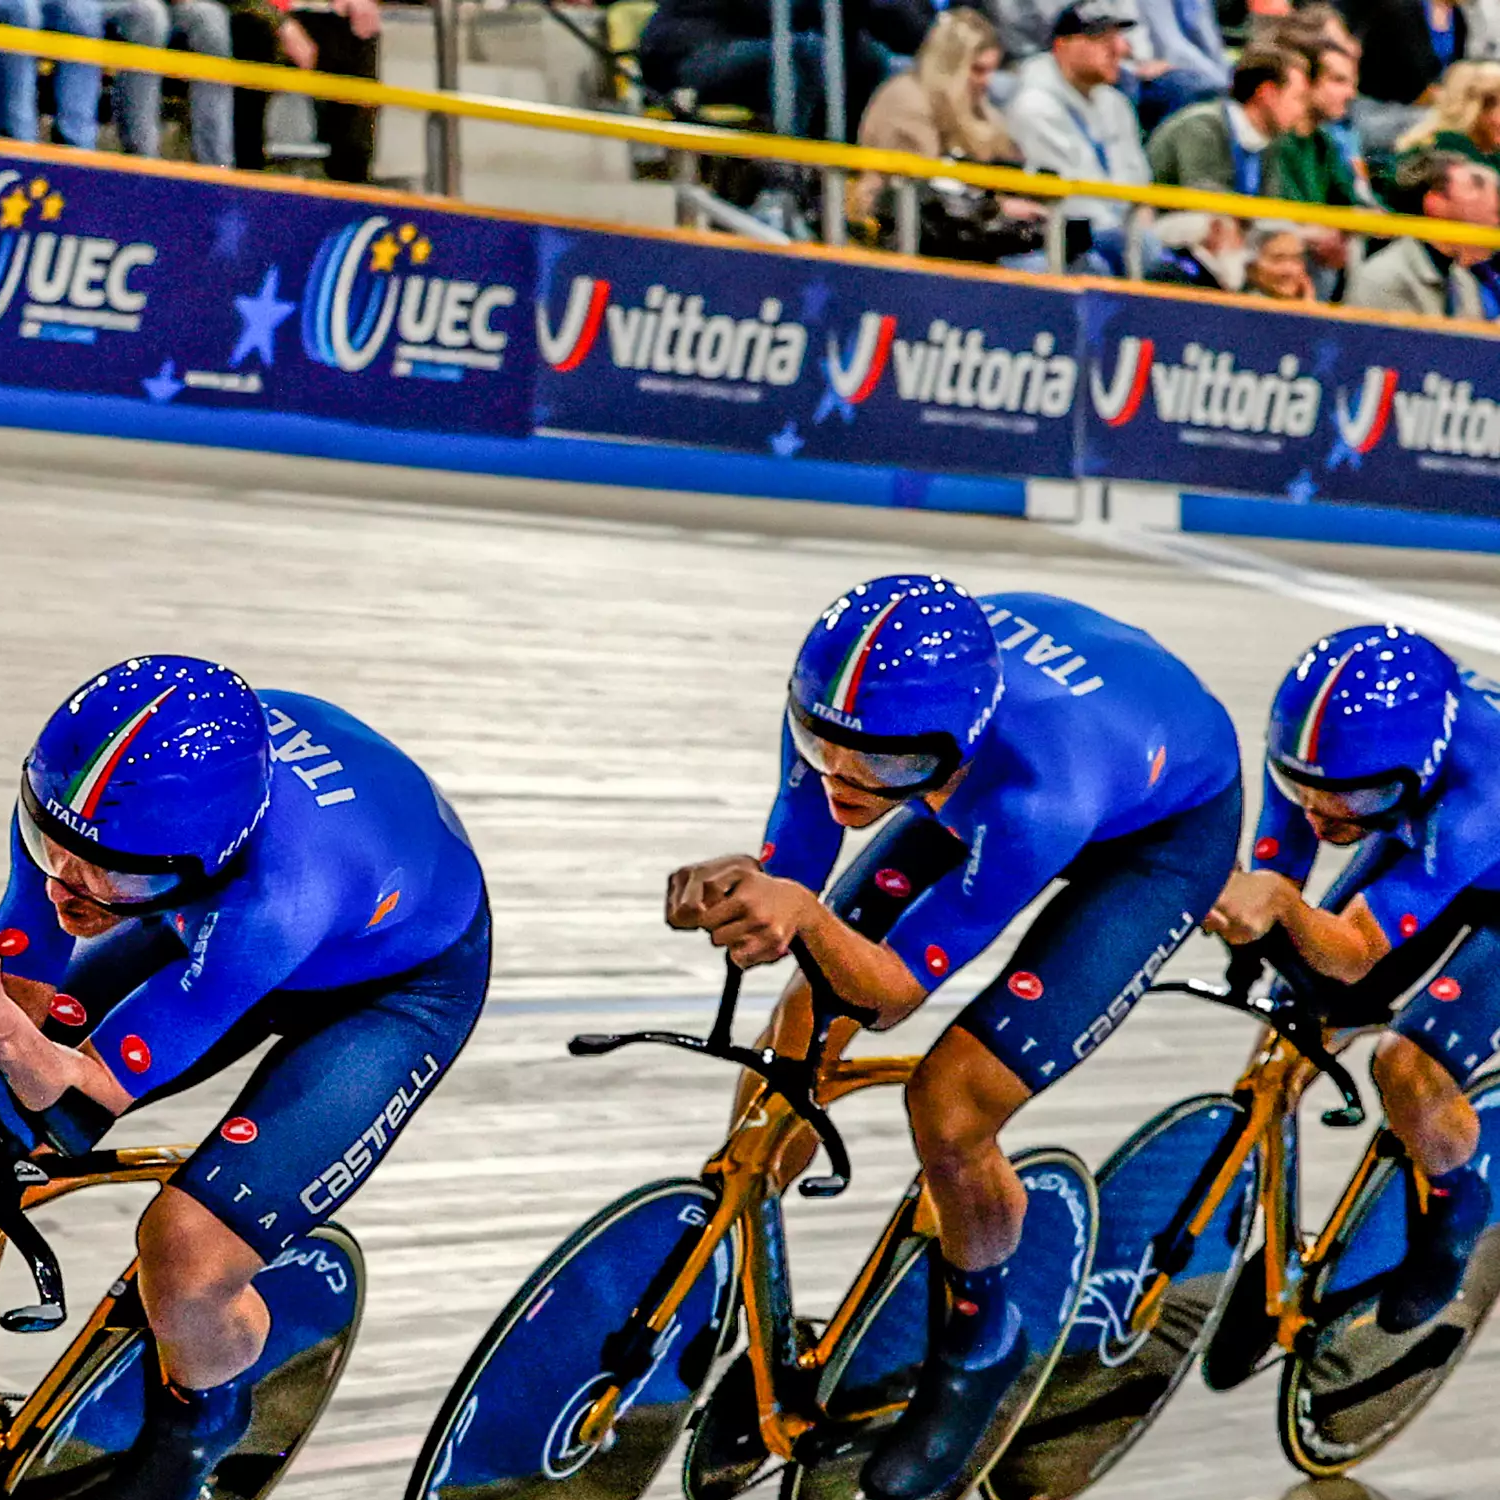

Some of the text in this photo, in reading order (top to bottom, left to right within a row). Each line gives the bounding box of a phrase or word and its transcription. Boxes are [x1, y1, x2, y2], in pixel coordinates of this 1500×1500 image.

[26, 232, 157, 313] UEC
[398, 276, 515, 351] UEC
[606, 284, 808, 386] vittoria
[892, 319, 1078, 417] vittoria
[1151, 342, 1322, 438] vittoria
[46, 799, 100, 842] ITALIA
